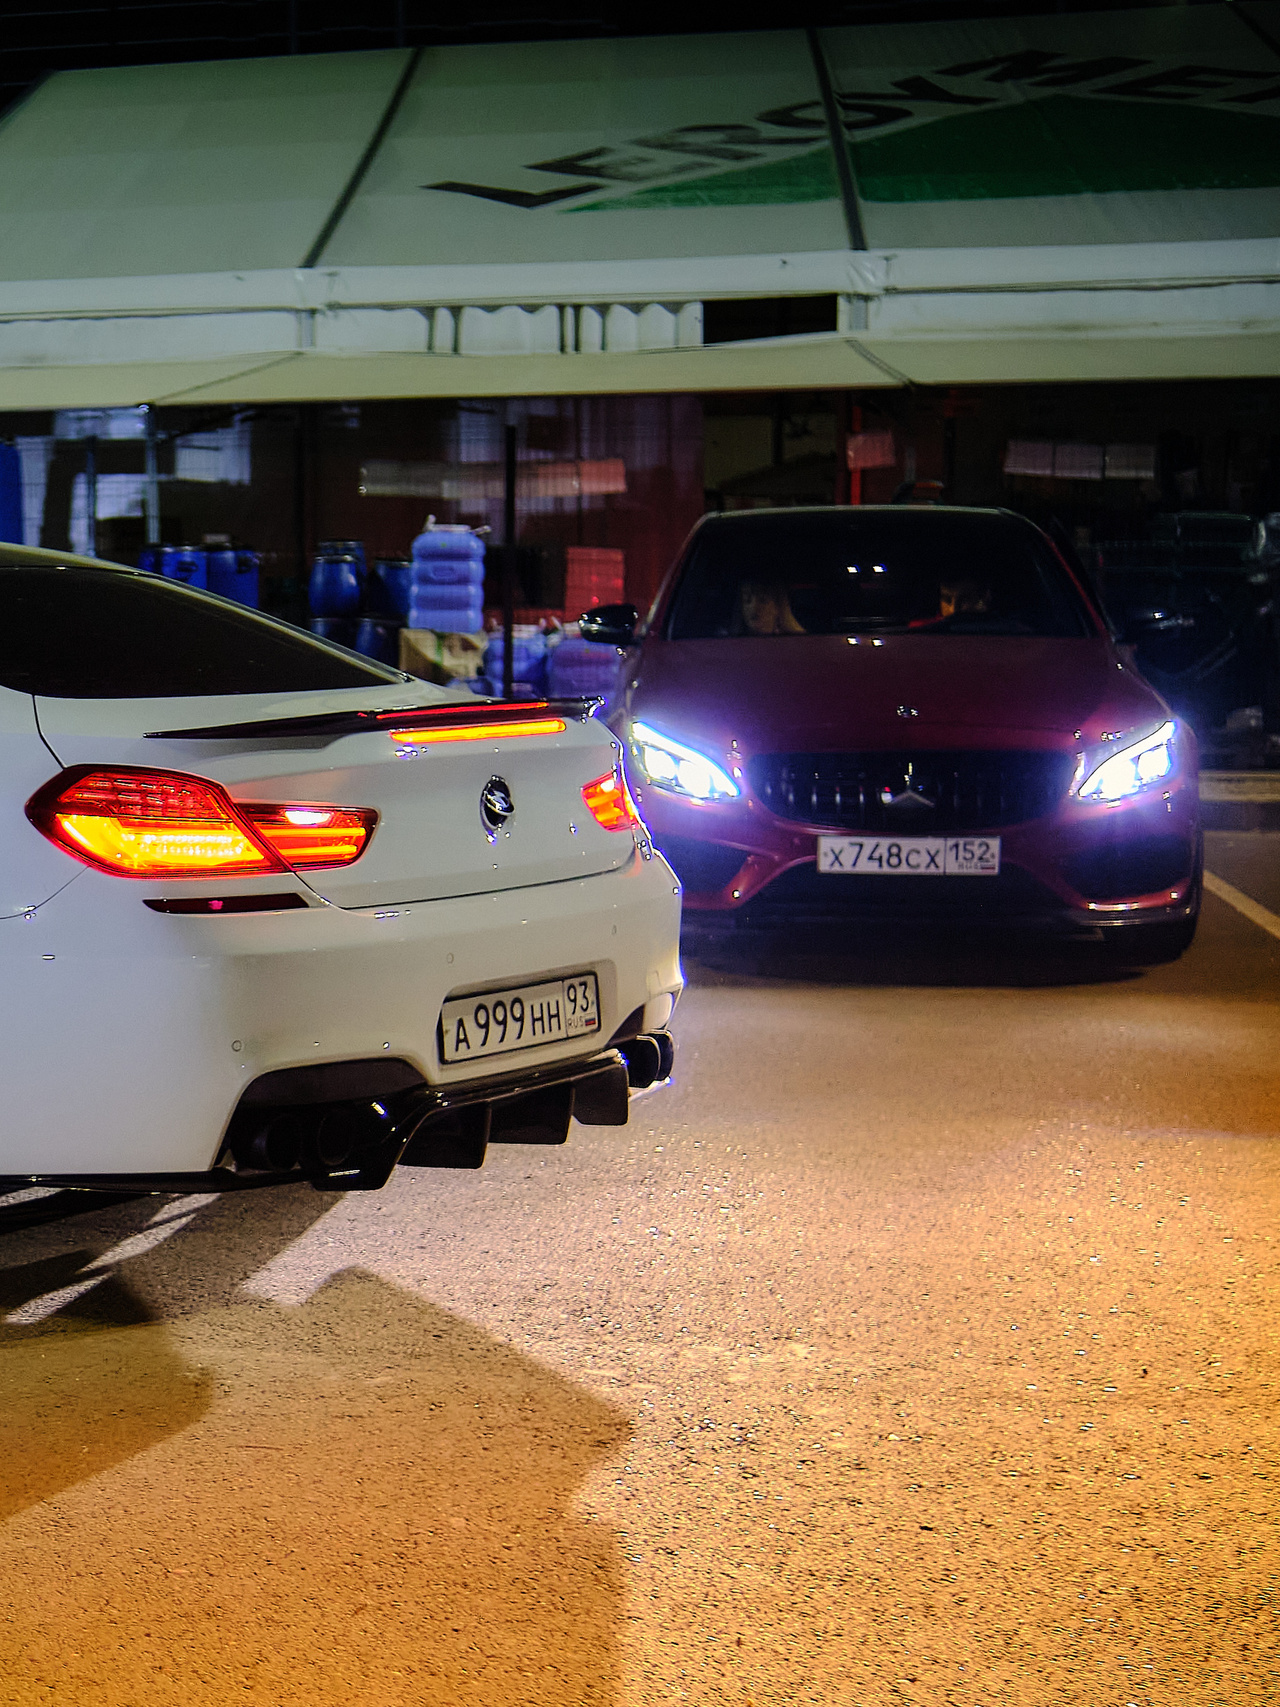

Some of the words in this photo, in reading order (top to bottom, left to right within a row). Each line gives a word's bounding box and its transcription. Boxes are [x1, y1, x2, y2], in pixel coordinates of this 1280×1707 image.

[419, 75, 999, 209] LEROY
[949, 840, 990, 863] 152
[566, 980, 590, 1015] 93
